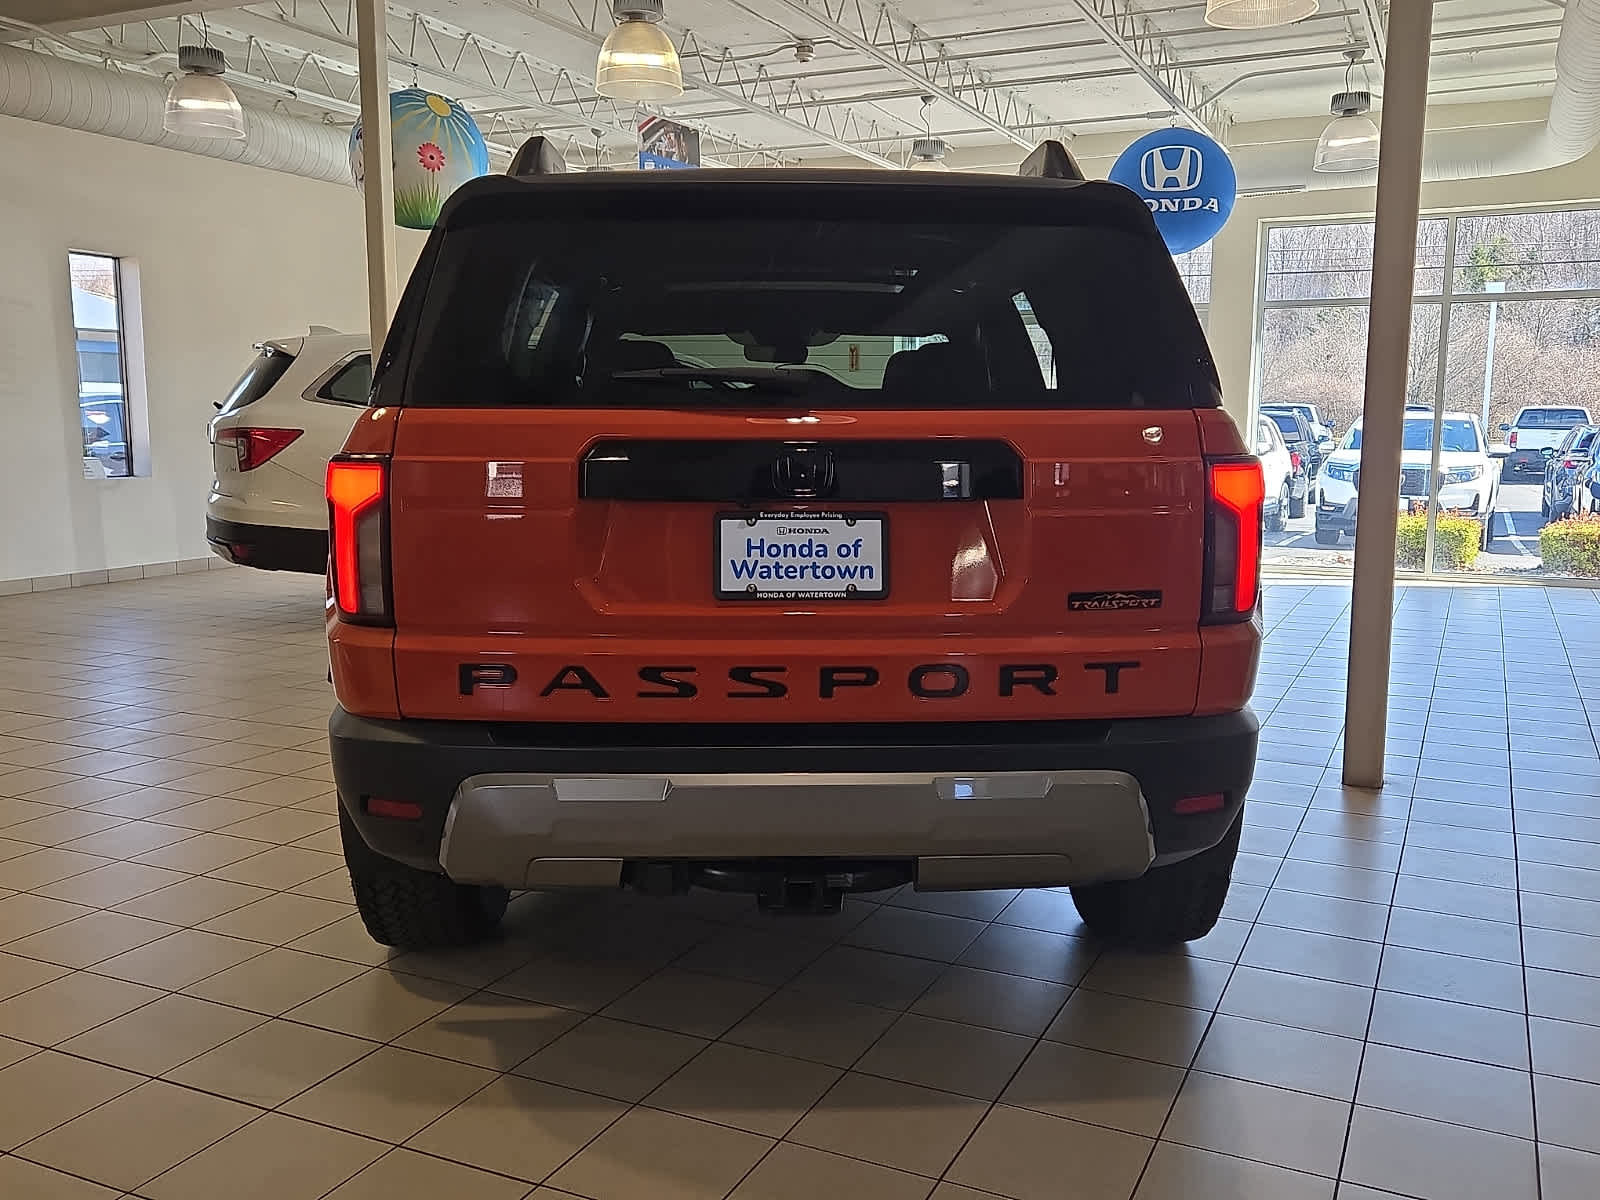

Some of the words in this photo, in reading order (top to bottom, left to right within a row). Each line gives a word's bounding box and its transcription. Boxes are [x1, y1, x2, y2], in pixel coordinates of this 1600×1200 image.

[1143, 197, 1219, 213] ONDA
[760, 511, 789, 520] Everyday
[791, 511, 820, 520] Employee
[788, 527, 830, 535] HONDA
[746, 538, 828, 558] Honda
[836, 538, 863, 558] of
[730, 559, 874, 580] Watertown
[756, 591, 784, 599] HONDA
[786, 591, 797, 599] OF
[798, 591, 847, 599] WATERTOWN
[1071, 598, 1161, 610] TRAILSPORT
[458, 661, 1140, 699] PASSPORT
